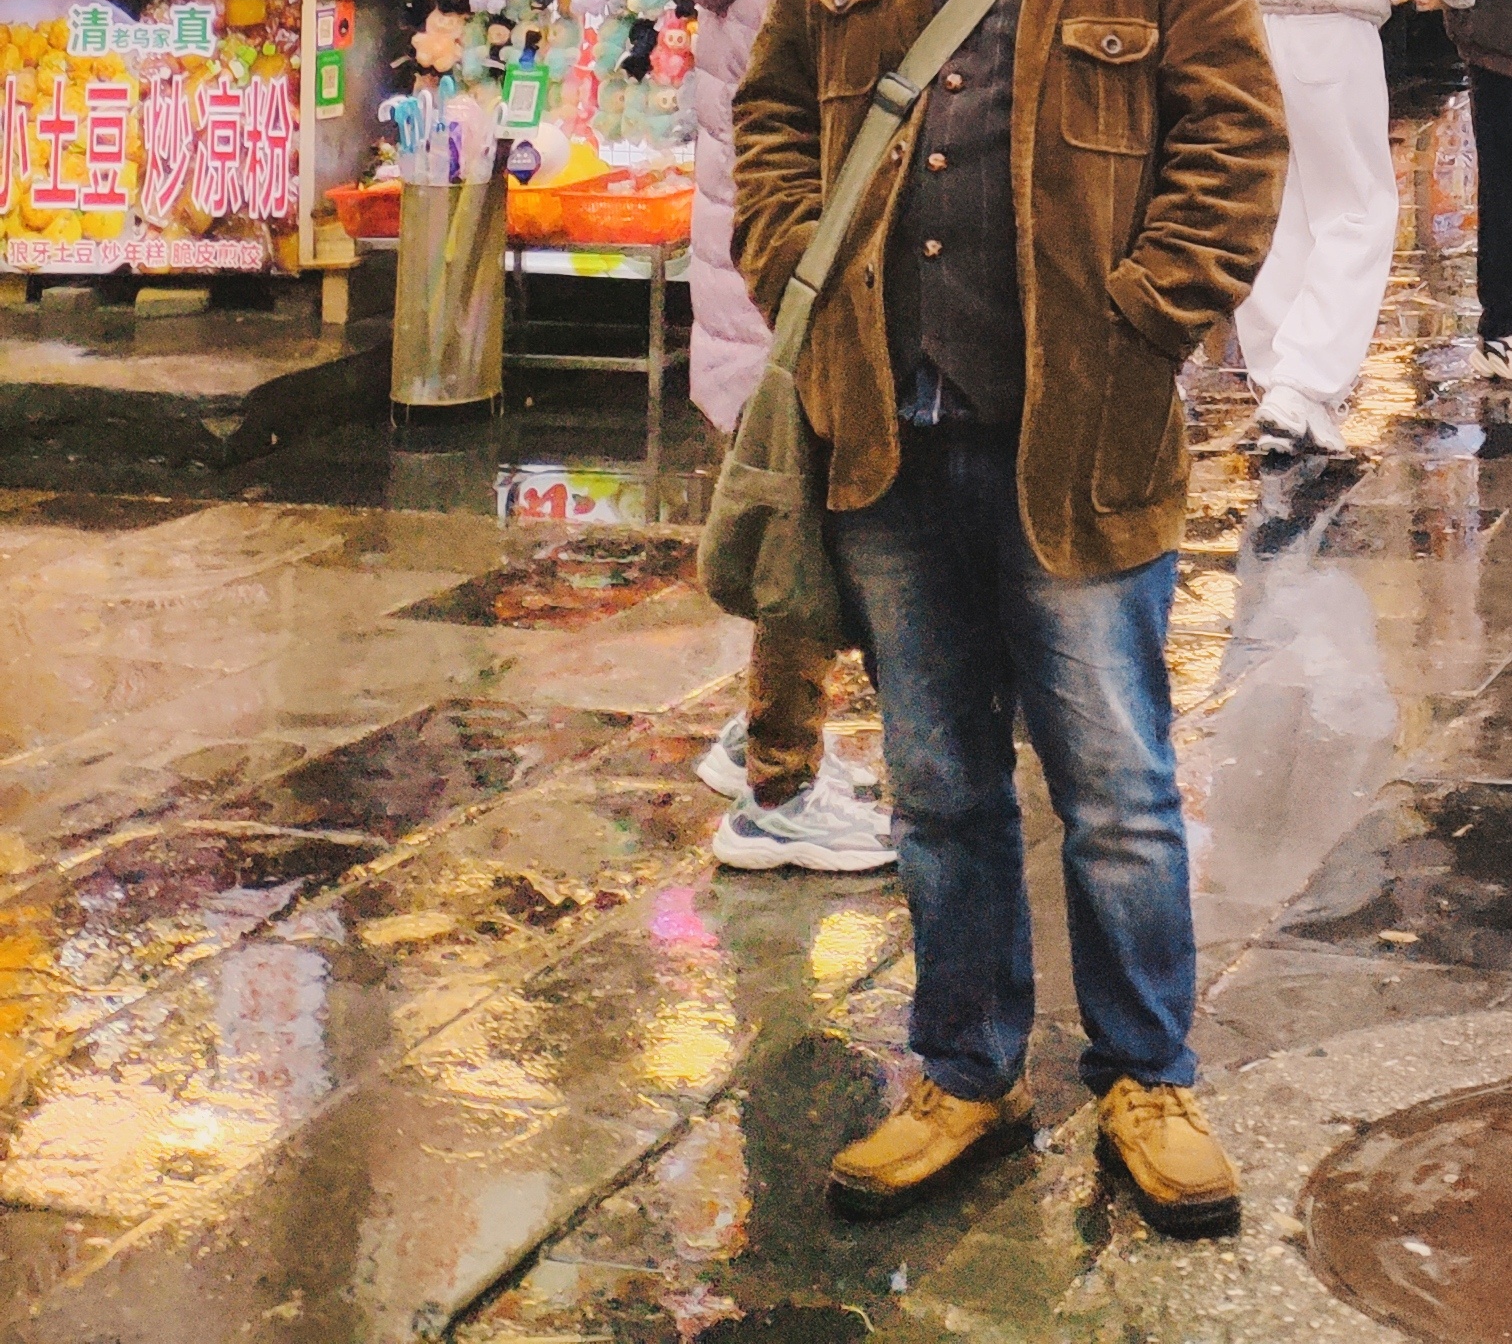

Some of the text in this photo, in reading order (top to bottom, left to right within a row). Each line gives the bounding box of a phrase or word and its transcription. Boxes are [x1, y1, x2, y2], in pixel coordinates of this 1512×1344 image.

[71, 6, 212, 53] 清 老乌家 真
[143, 75, 292, 218] 炒凉粉
[10, 241, 262, 269] 狼牙土豆 炒年糕 脆皮煎饺
